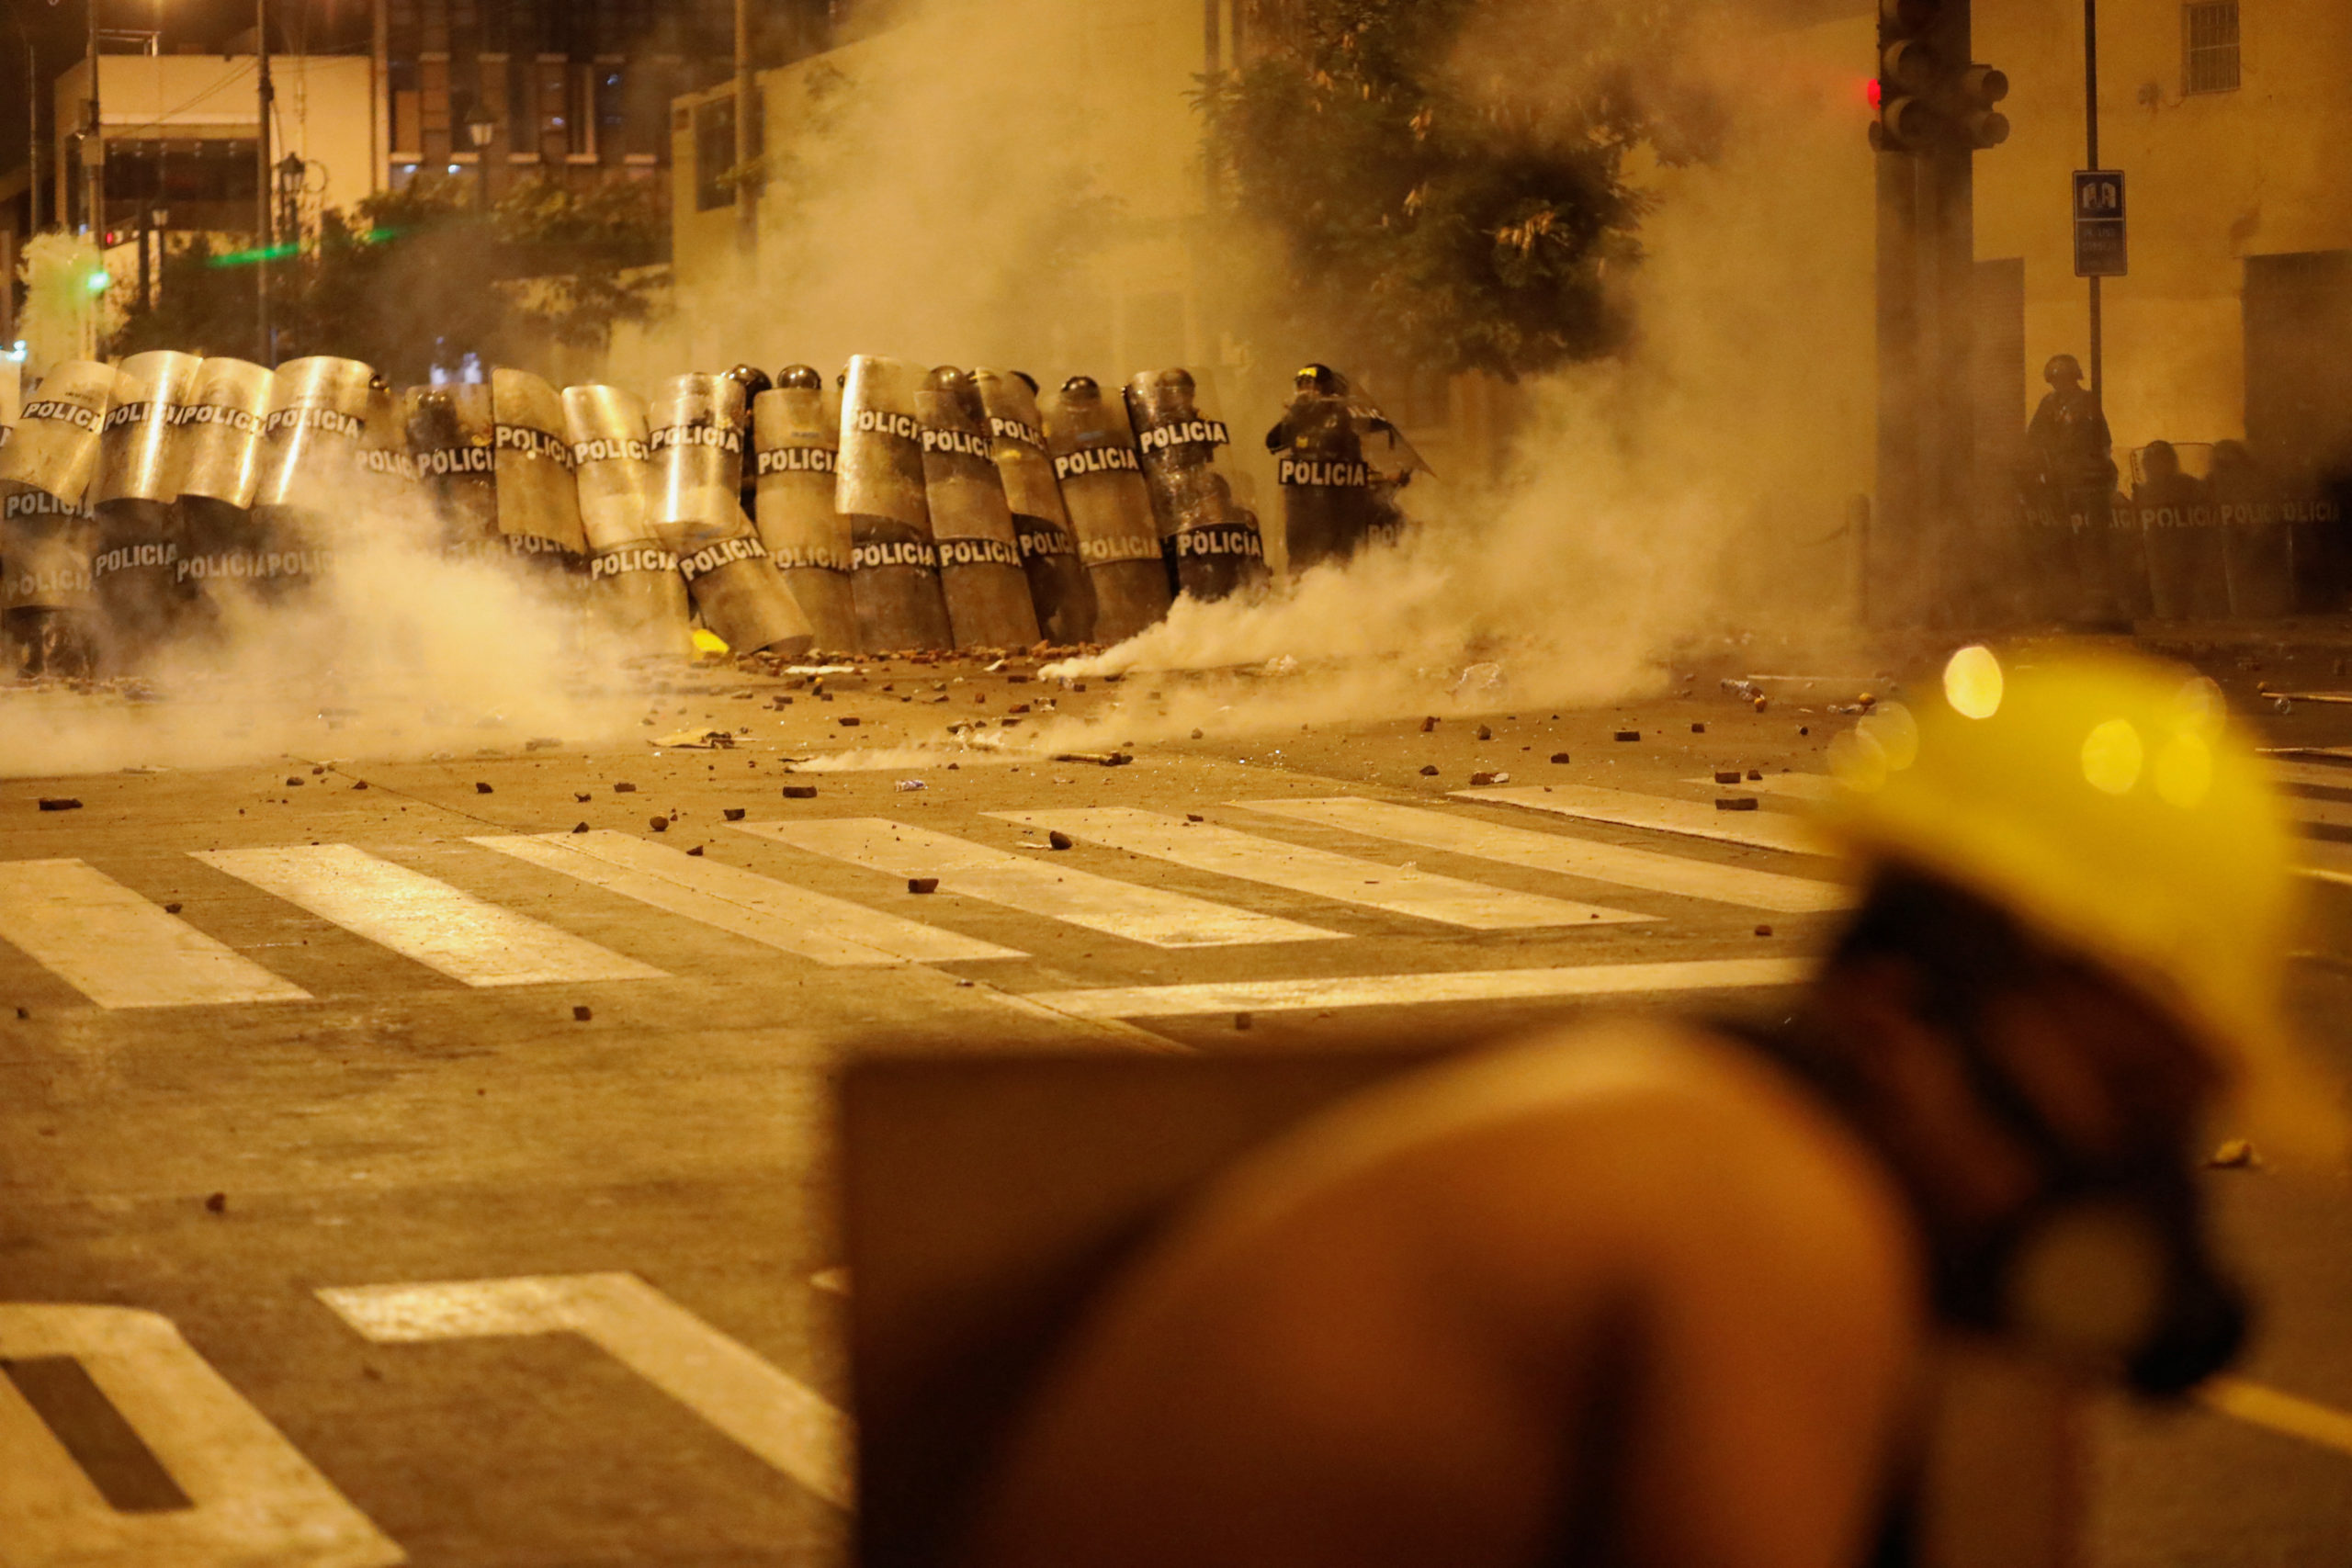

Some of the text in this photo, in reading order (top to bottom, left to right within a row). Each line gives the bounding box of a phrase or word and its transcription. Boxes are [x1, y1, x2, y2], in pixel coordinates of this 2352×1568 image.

[105, 402, 184, 431] POLII
[268, 408, 358, 438] POLICIA
[495, 425, 574, 470] POLICIA
[651, 426, 740, 453] POLICIA
[922, 431, 991, 459] POLICI
[990, 417, 1044, 450] POLIC
[1140, 422, 1227, 454] POLICIA
[355, 449, 415, 479] POLIC
[417, 447, 493, 477] POLICI
[574, 439, 649, 464] POLICI
[1055, 447, 1138, 479] POLICIA
[1281, 460, 1366, 486] POLICIA
[680, 537, 766, 581] POLICIA
[853, 542, 936, 570] POLICIA
[939, 541, 1022, 567] POLICIA
[1019, 533, 1071, 557] POLIC
[1079, 536, 1162, 558] POLICIA
[1179, 532, 1261, 557] POLICIA
[96, 544, 176, 577] POLICIA
[177, 553, 266, 582] POLICIA
[591, 550, 678, 581] POLICIA
